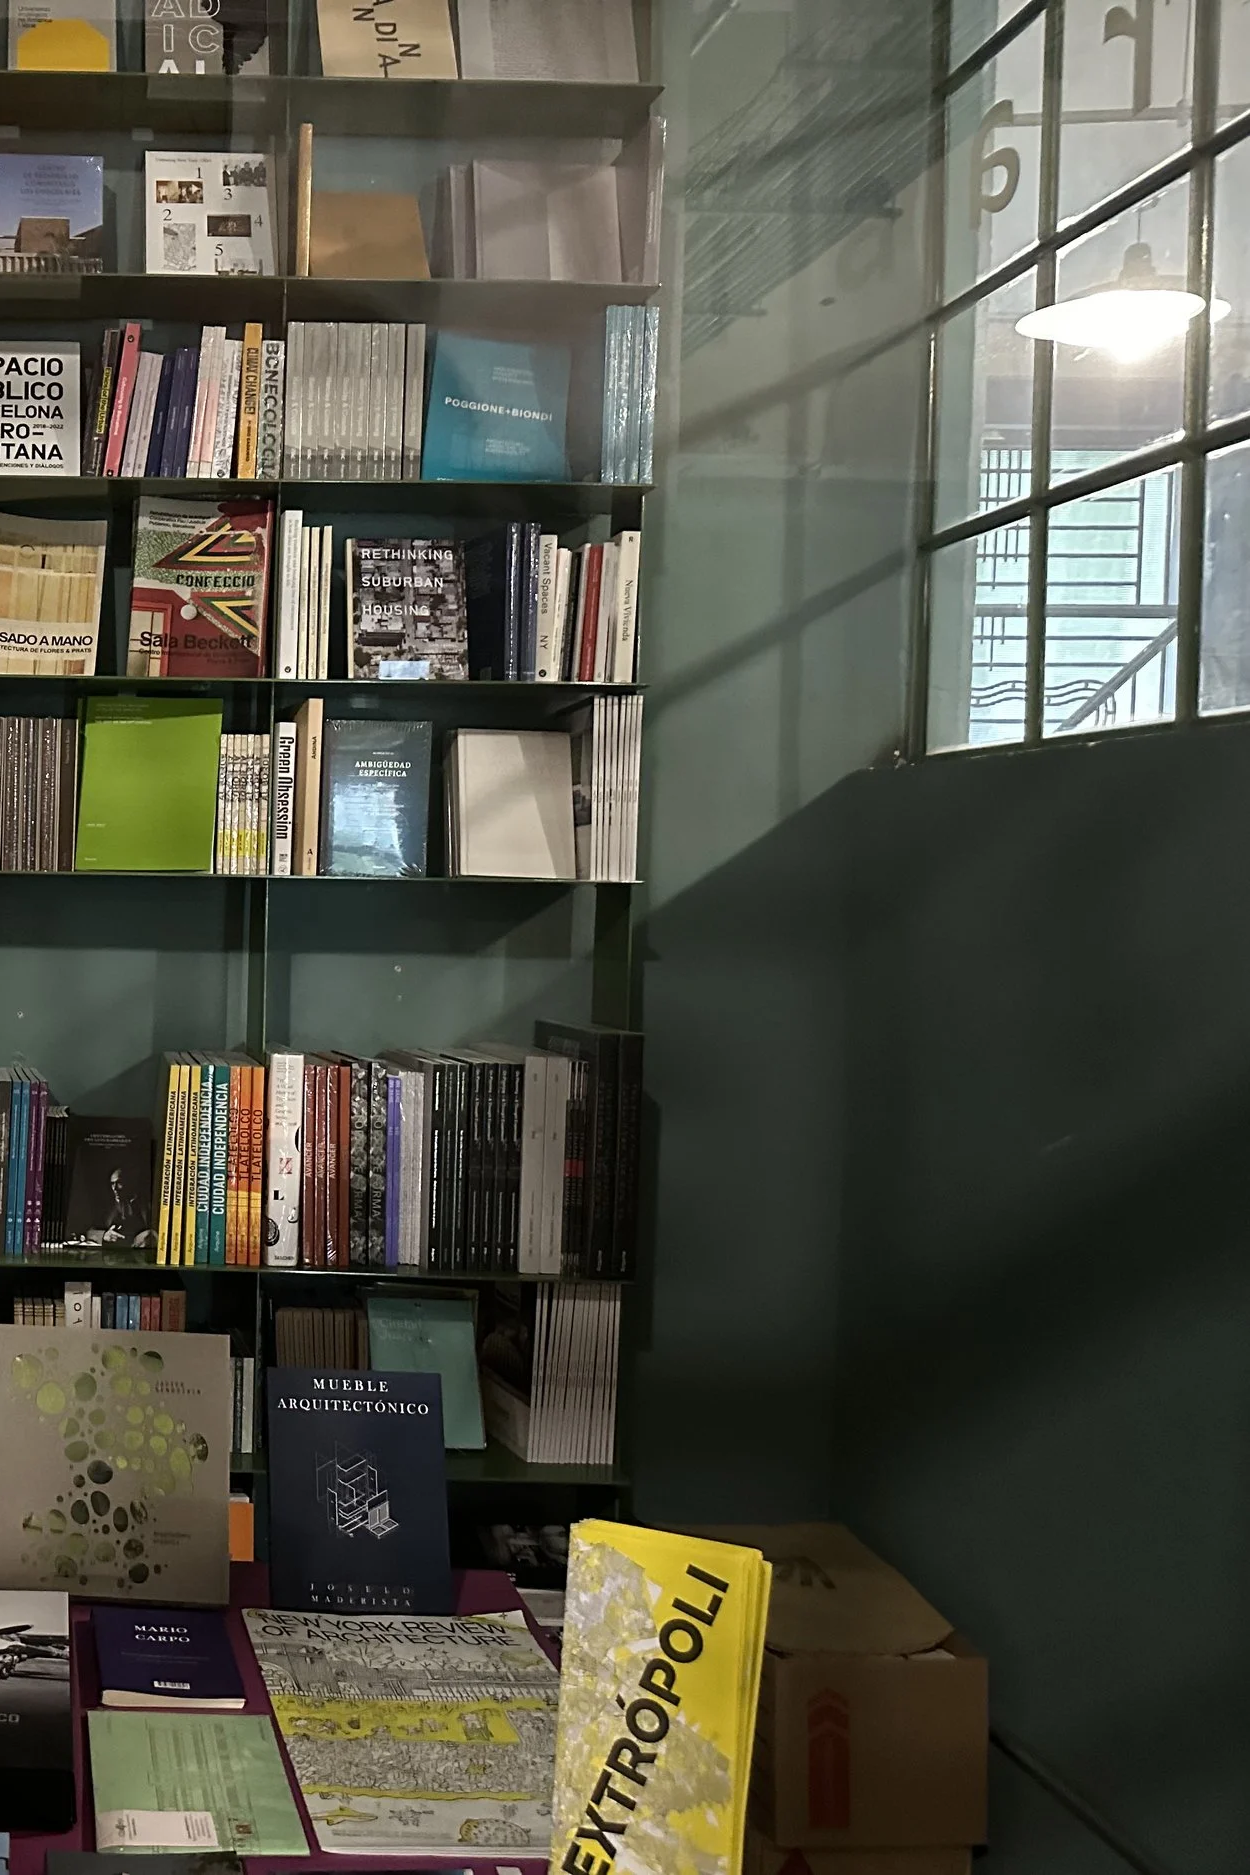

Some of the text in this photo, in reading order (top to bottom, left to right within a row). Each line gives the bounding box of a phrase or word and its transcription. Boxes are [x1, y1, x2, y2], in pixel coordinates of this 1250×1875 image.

[224, 188, 233, 200] 3
[163, 209, 172, 221] 2
[254, 214, 263, 227] 4
[215, 244, 224, 256] 5
[103, 368, 112, 389] Ethics
[244, 347, 258, 415] CLIMAX CHANGE!
[444, 396, 553, 421] POGGIONE+BIONDI
[97, 411, 106, 433] Urban
[361, 549, 453, 560] RETHINKING
[361, 577, 444, 588] SUBURBAN
[539, 543, 553, 651] Vacant Spaces NY
[362, 604, 431, 616] HOUSING
[622, 579, 633, 642] Nueva Vivienda
[39, 636, 49, 646] A
[51, 635, 93, 646] MANO
[140, 631, 252, 651] Sala Beckett
[355, 760, 411, 770] AMBIGÜEDAD
[359, 769, 407, 777] ESPECÍFICA
[276, 736, 295, 840] Green Obsession
[178, 1090, 187, 1156] LATINOAMERICANA
[162, 1090, 176, 1207] INTEGRACIÓN LATINOAMERICANA
[196, 1080, 213, 1212] CIUDAD INDEPENDENCIA
[212, 1082, 229, 1215] CIUDAD INDEPENDENCIA
[240, 1108, 250, 1181] TLATELOLCO
[251, 1109, 263, 1182] TLATELOLCO
[188, 1160, 196, 1208] INTEGRACIÓN
[313, 1378, 389, 1393] MUEBLE
[278, 1398, 429, 1415] ARQUITECTÓNICO
[310, 1582, 411, 1595] JOSELO
[311, 1595, 411, 1607] MADERISTA
[134, 1624, 189, 1634] MARIO
[261, 1613, 508, 1635] NEW YORK REVIEW
[135, 1633, 190, 1643] CARPO
[261, 1625, 521, 1646] OF ARCHITECTURE
[561, 1563, 730, 1875] EXTRÓPOLI
